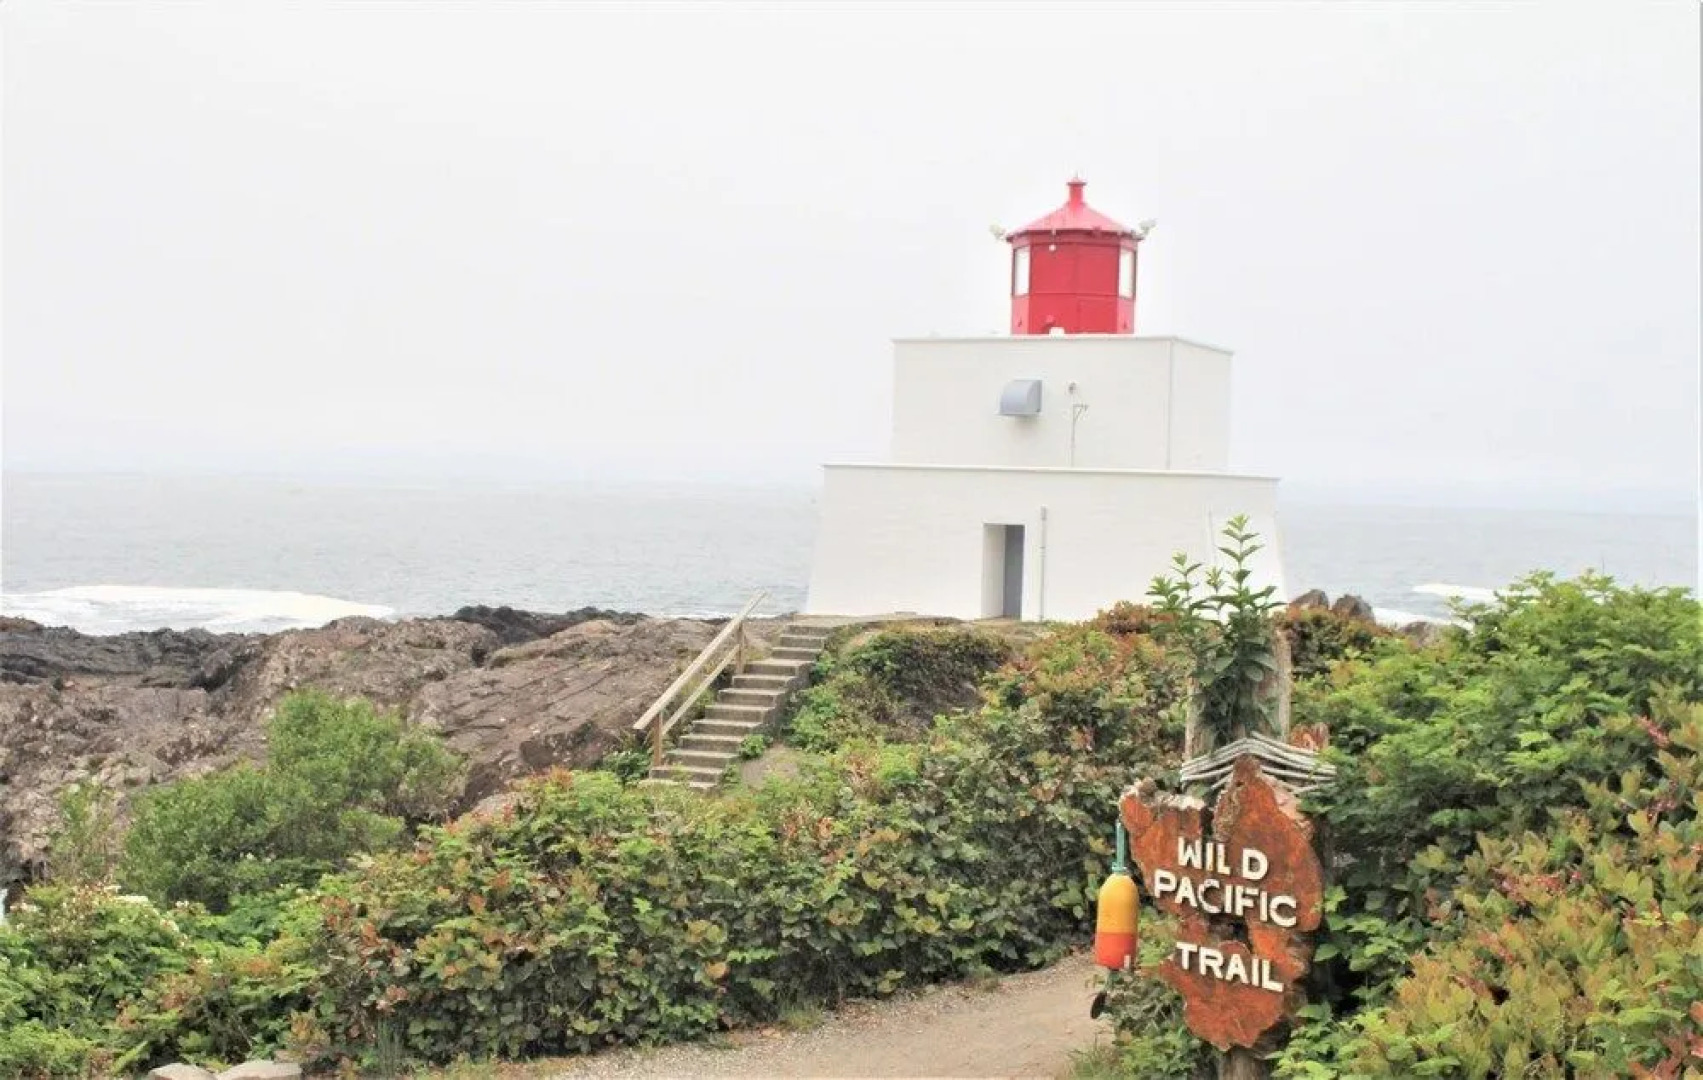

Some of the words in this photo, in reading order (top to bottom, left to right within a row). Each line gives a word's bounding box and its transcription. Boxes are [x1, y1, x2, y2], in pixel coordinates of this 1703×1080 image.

[1177, 837, 1268, 880] WILD
[1153, 870, 1297, 927] PACIFIC
[1176, 941, 1284, 992] TRAIL
